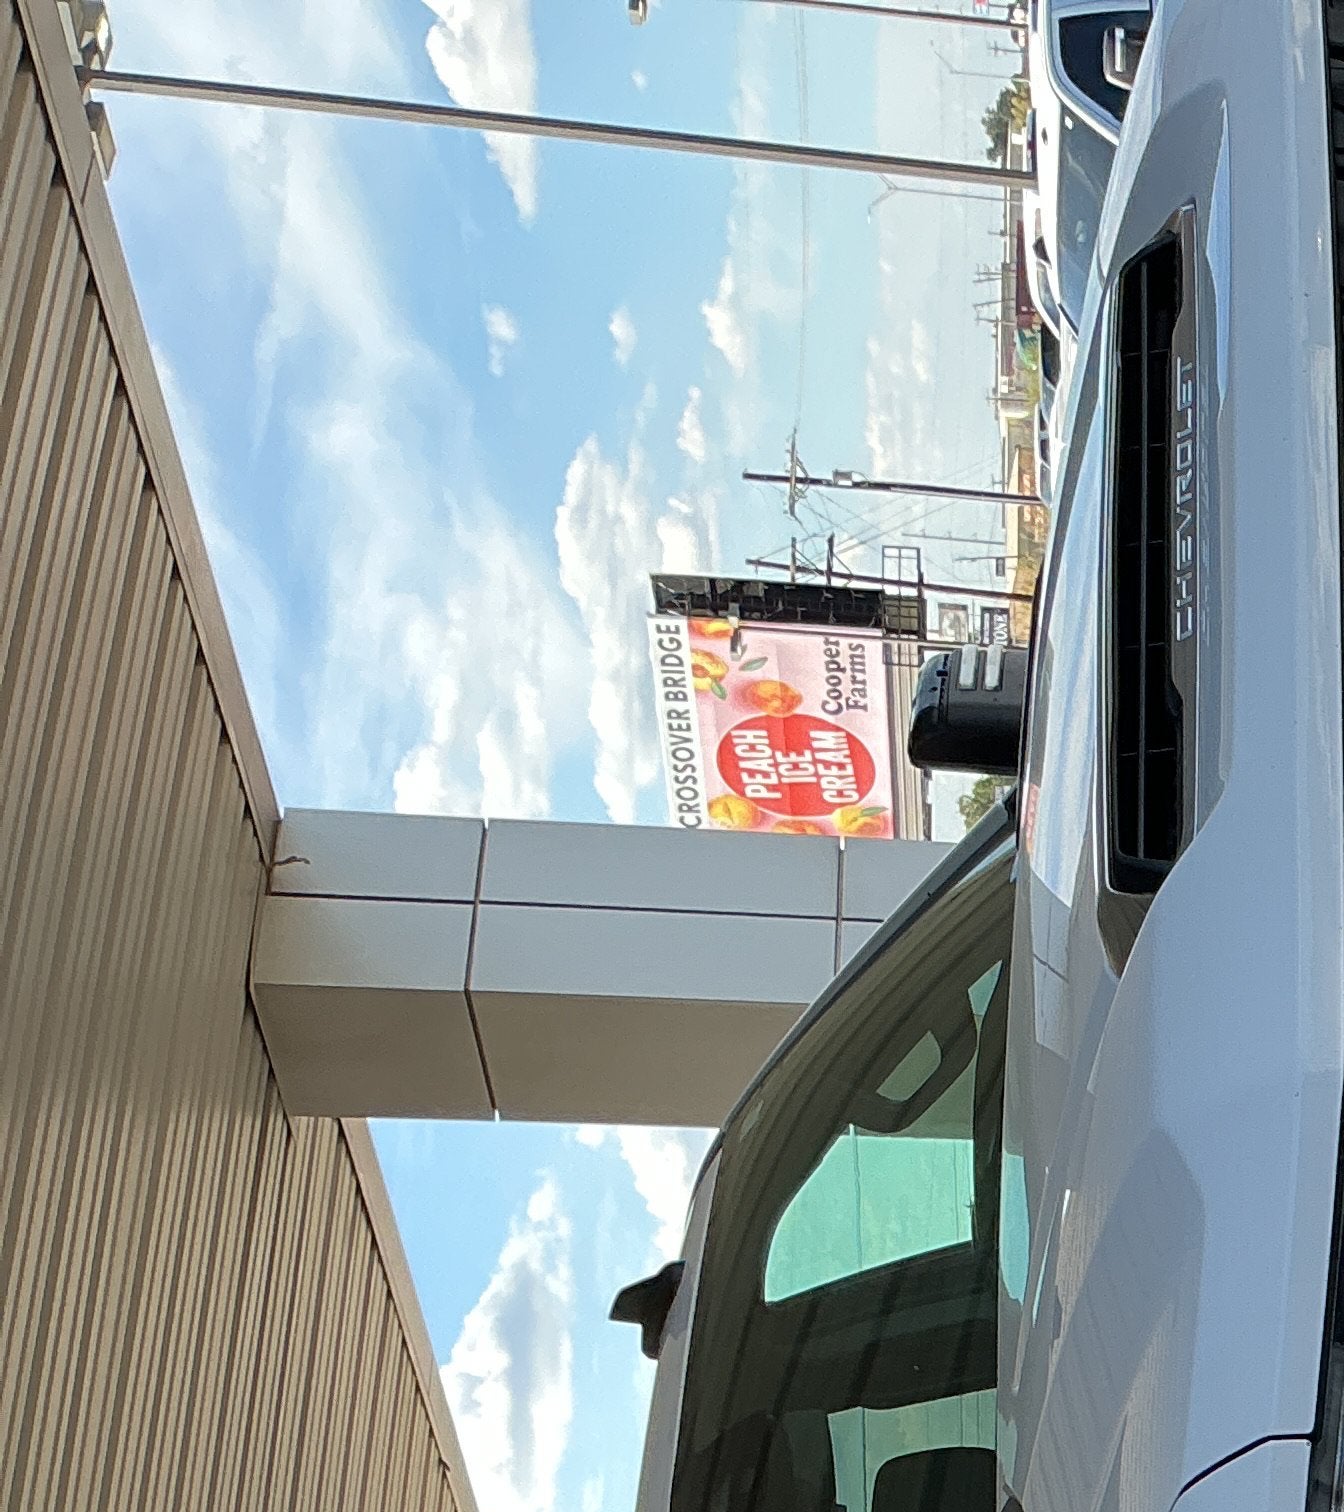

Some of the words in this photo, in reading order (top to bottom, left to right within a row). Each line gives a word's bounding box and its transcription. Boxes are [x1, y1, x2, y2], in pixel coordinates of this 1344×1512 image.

[1176, 355, 1194, 642] CHEVROLET
[655, 623, 687, 702] BRIDGE
[821, 634, 848, 716] Cooper
[845, 642, 869, 713] Farms
[668, 705, 702, 828] CROSSOVER
[731, 728, 782, 800] PEACH
[775, 750, 816, 785] ICE
[811, 730, 859, 804] CREAM
